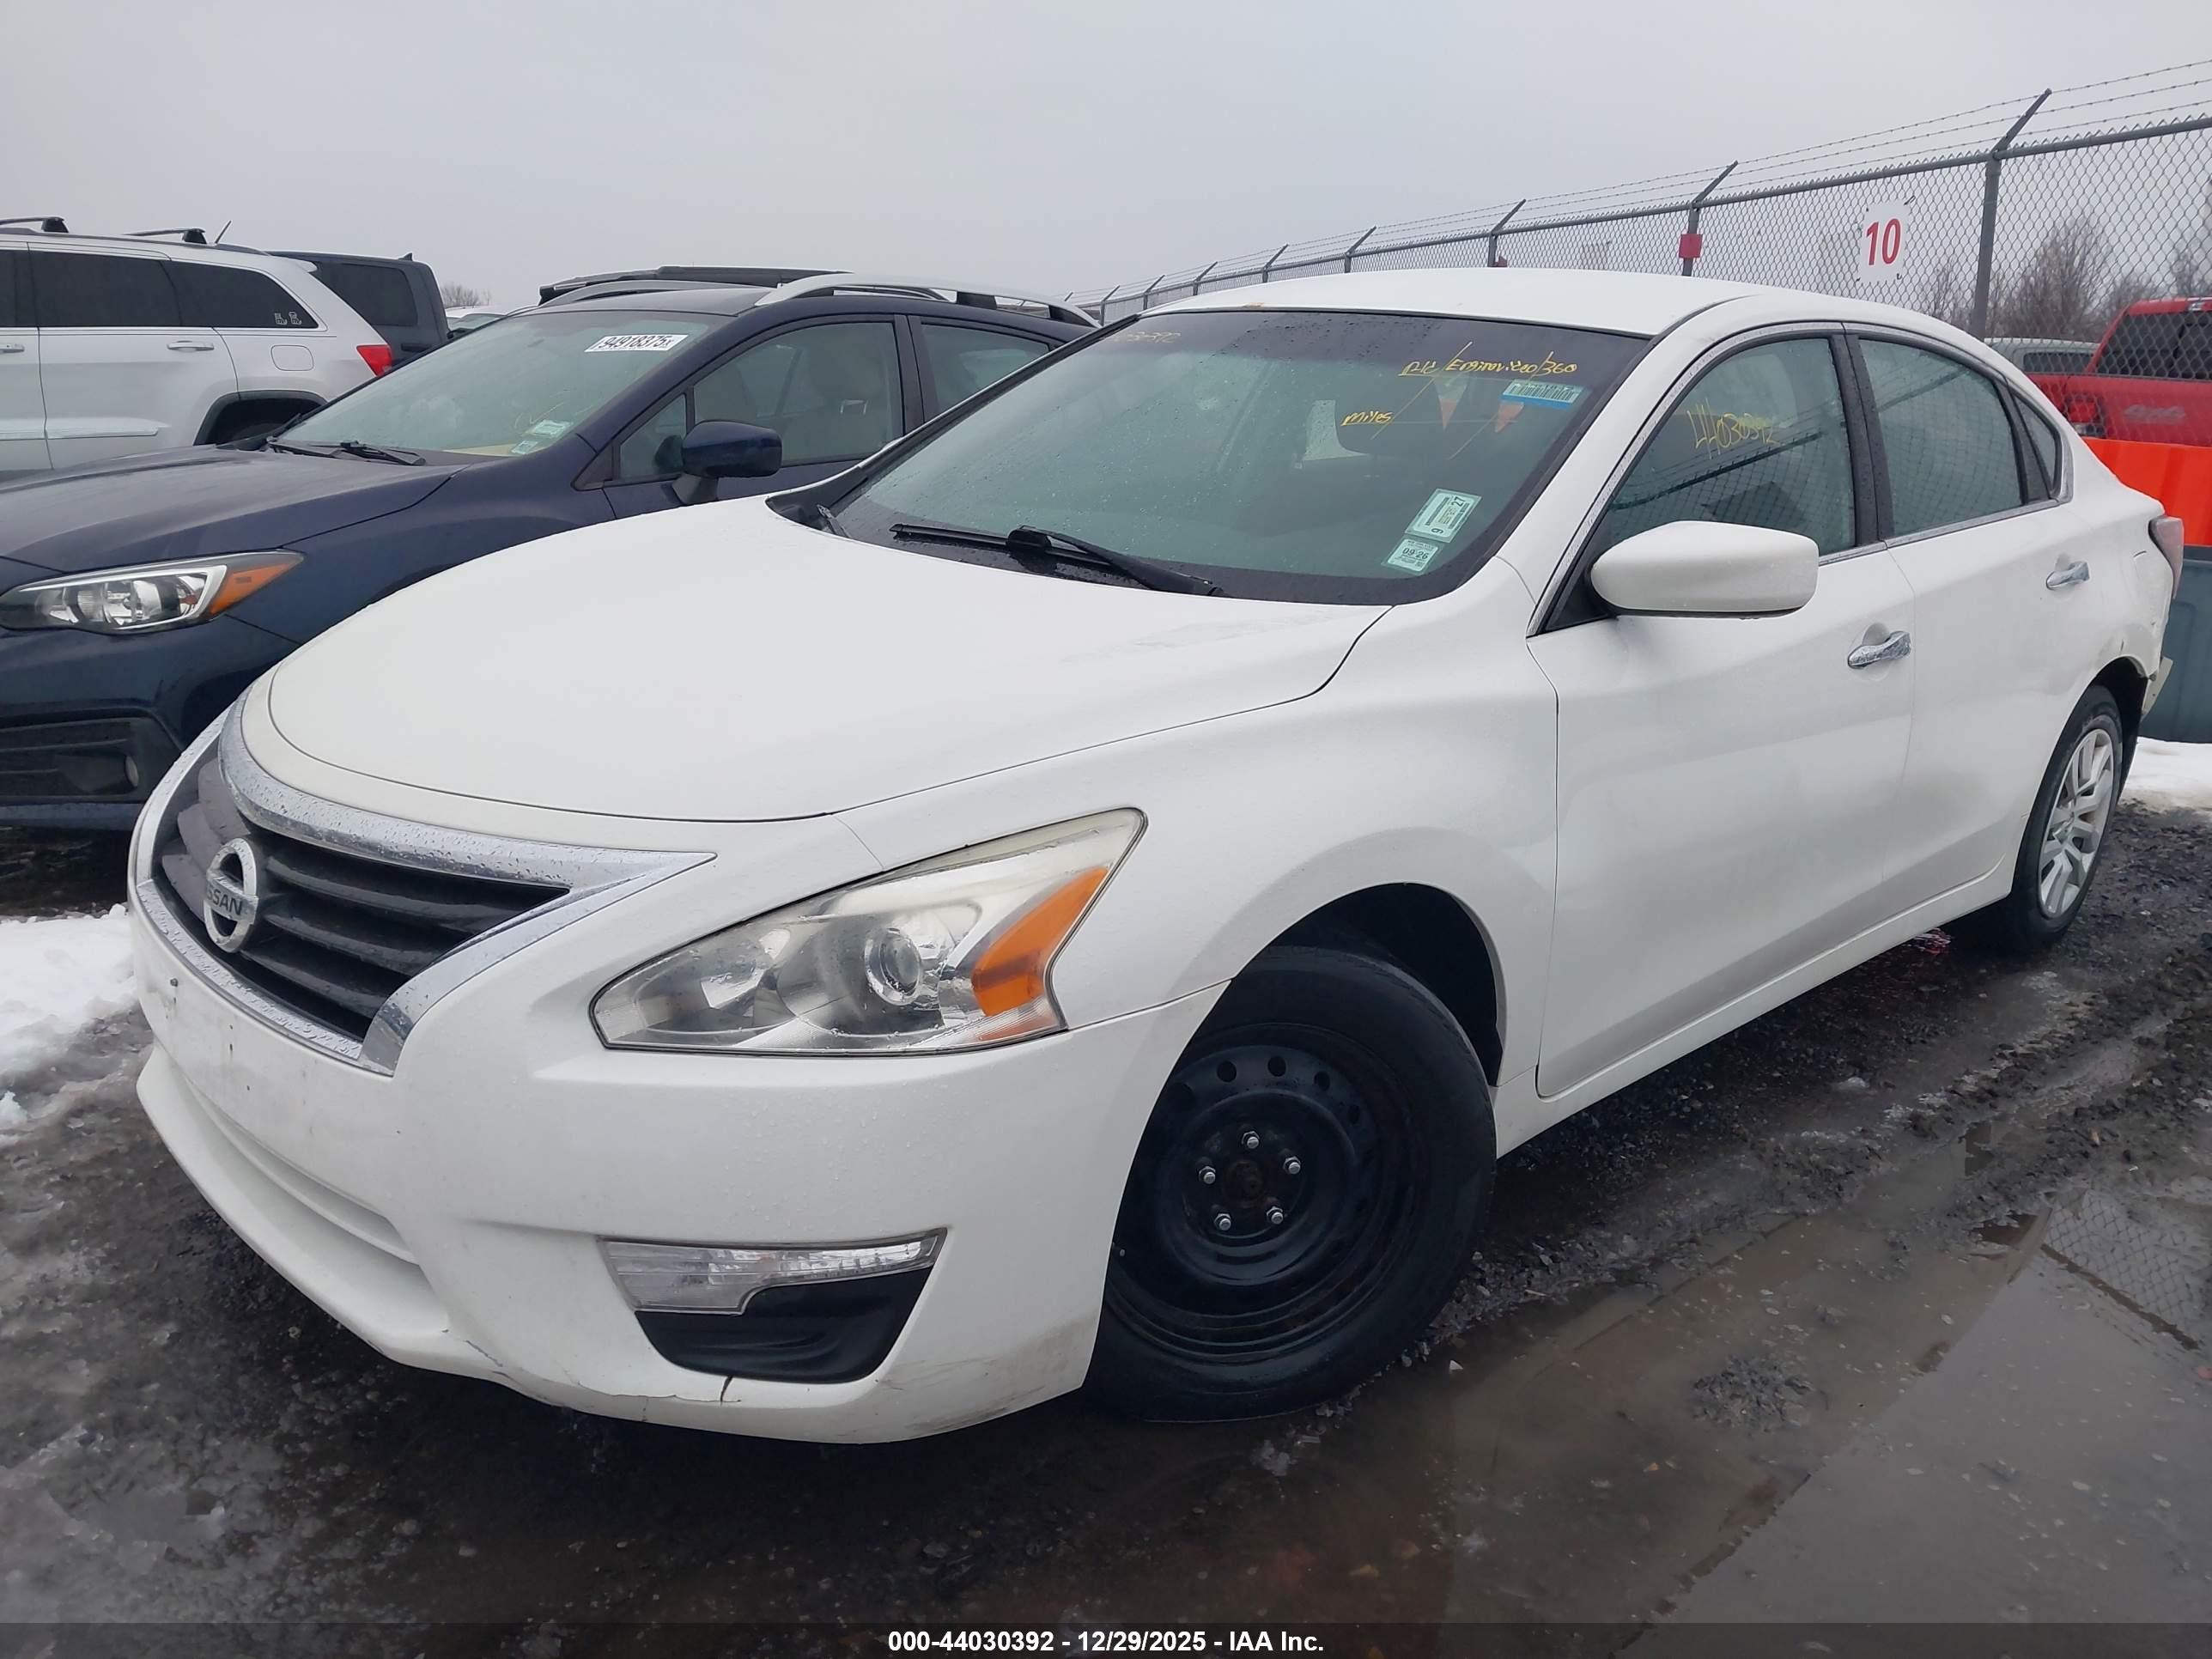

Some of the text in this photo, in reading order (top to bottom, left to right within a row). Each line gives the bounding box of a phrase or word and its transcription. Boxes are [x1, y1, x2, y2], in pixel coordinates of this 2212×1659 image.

[1866, 218, 1901, 266] 10
[1451, 495, 1466, 507] 27
[206, 883, 243, 916] SSAN
